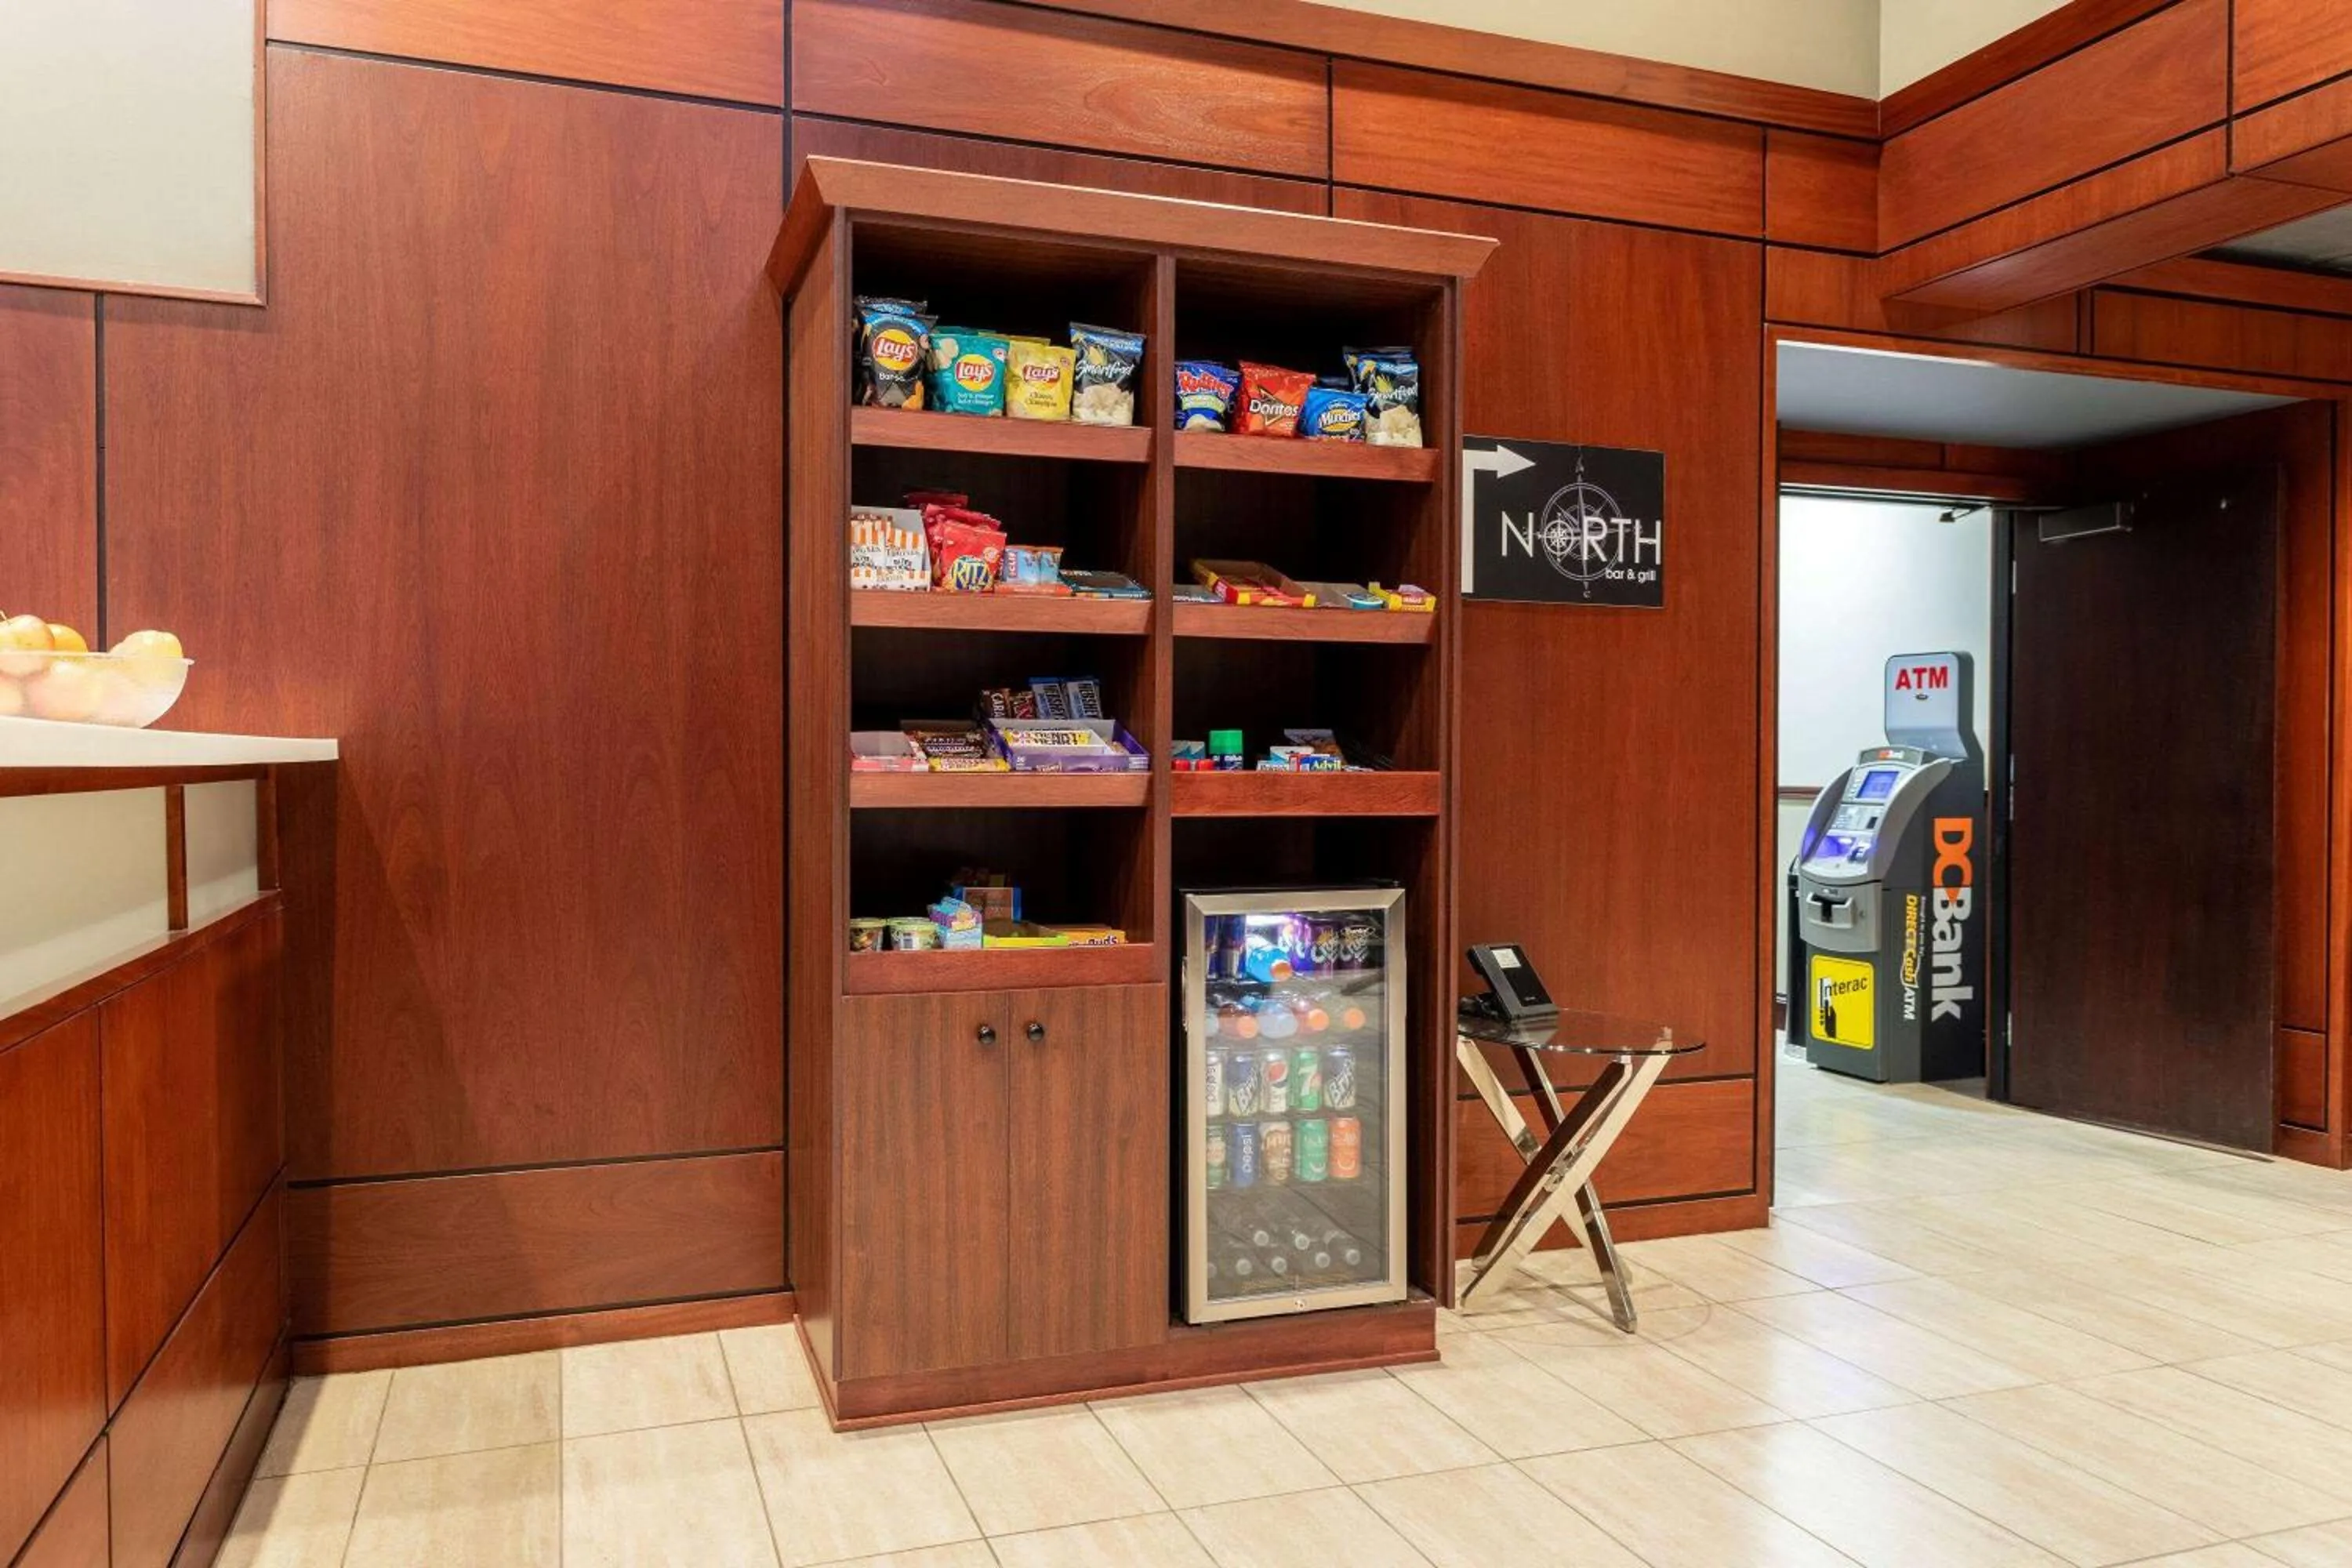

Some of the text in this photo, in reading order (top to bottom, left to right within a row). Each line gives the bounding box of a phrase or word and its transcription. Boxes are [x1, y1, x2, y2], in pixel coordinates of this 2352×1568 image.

[1250, 399, 1298, 417] Doritos
[1501, 510, 1661, 565] NORTH
[1606, 569, 1656, 583] bar & grill
[1895, 666, 1948, 690] ATM
[1313, 759, 1341, 770] Advil
[1820, 977, 1868, 1008] Interac
[1904, 986, 1915, 1020] ATM
[1241, 1134, 1254, 1174] pepsi
